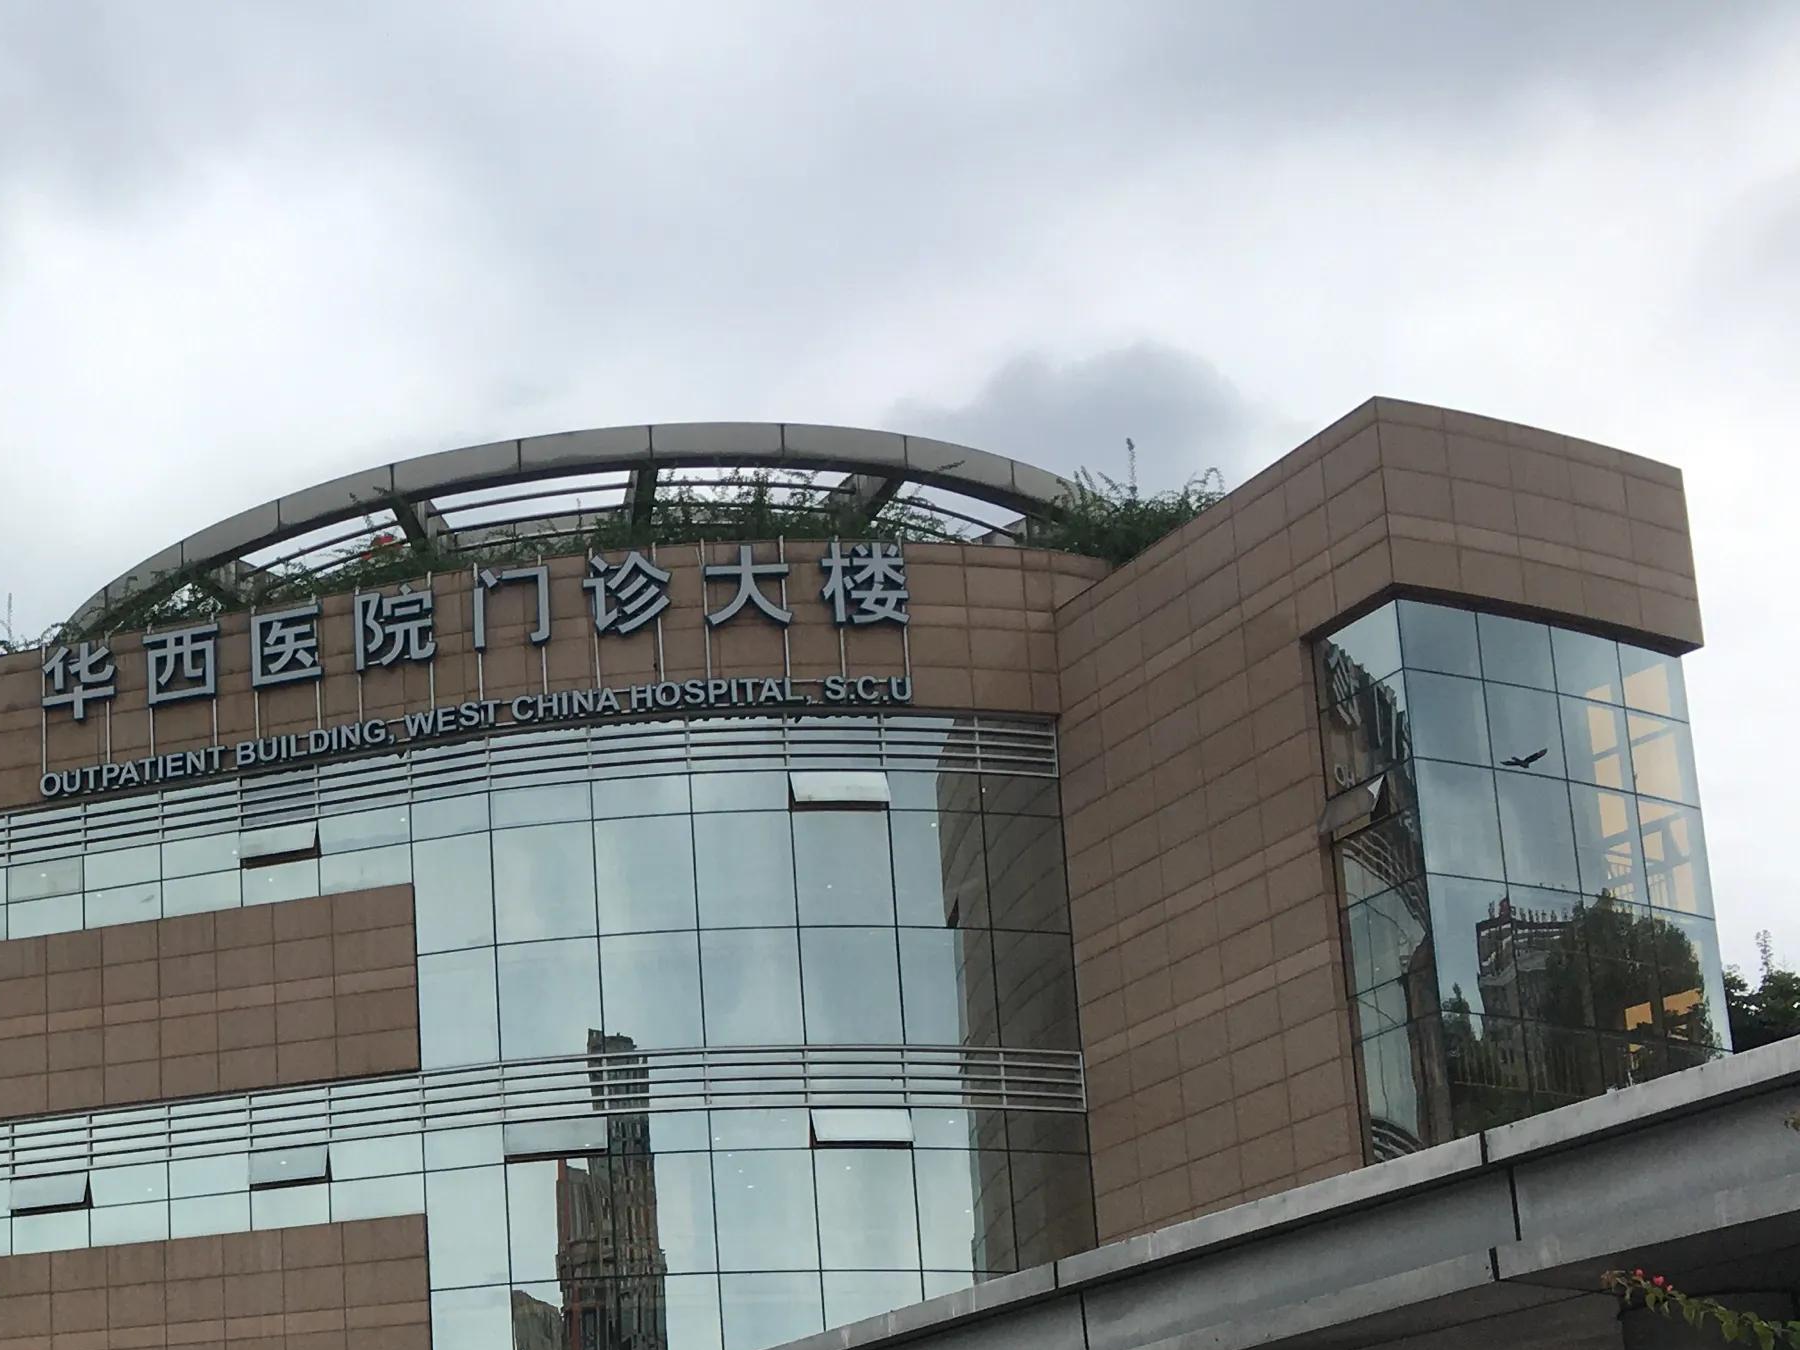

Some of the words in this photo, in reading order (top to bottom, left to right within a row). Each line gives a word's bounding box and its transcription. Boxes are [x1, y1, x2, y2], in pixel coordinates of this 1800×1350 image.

[42, 542, 911, 720] 华西医院门诊大楼
[40, 745, 226, 796] OUTPATIENT
[236, 719, 394, 765] BUILDING,
[405, 700, 500, 737] WEST
[512, 688, 620, 720] CHINA
[630, 677, 812, 709] HOSPITAL,
